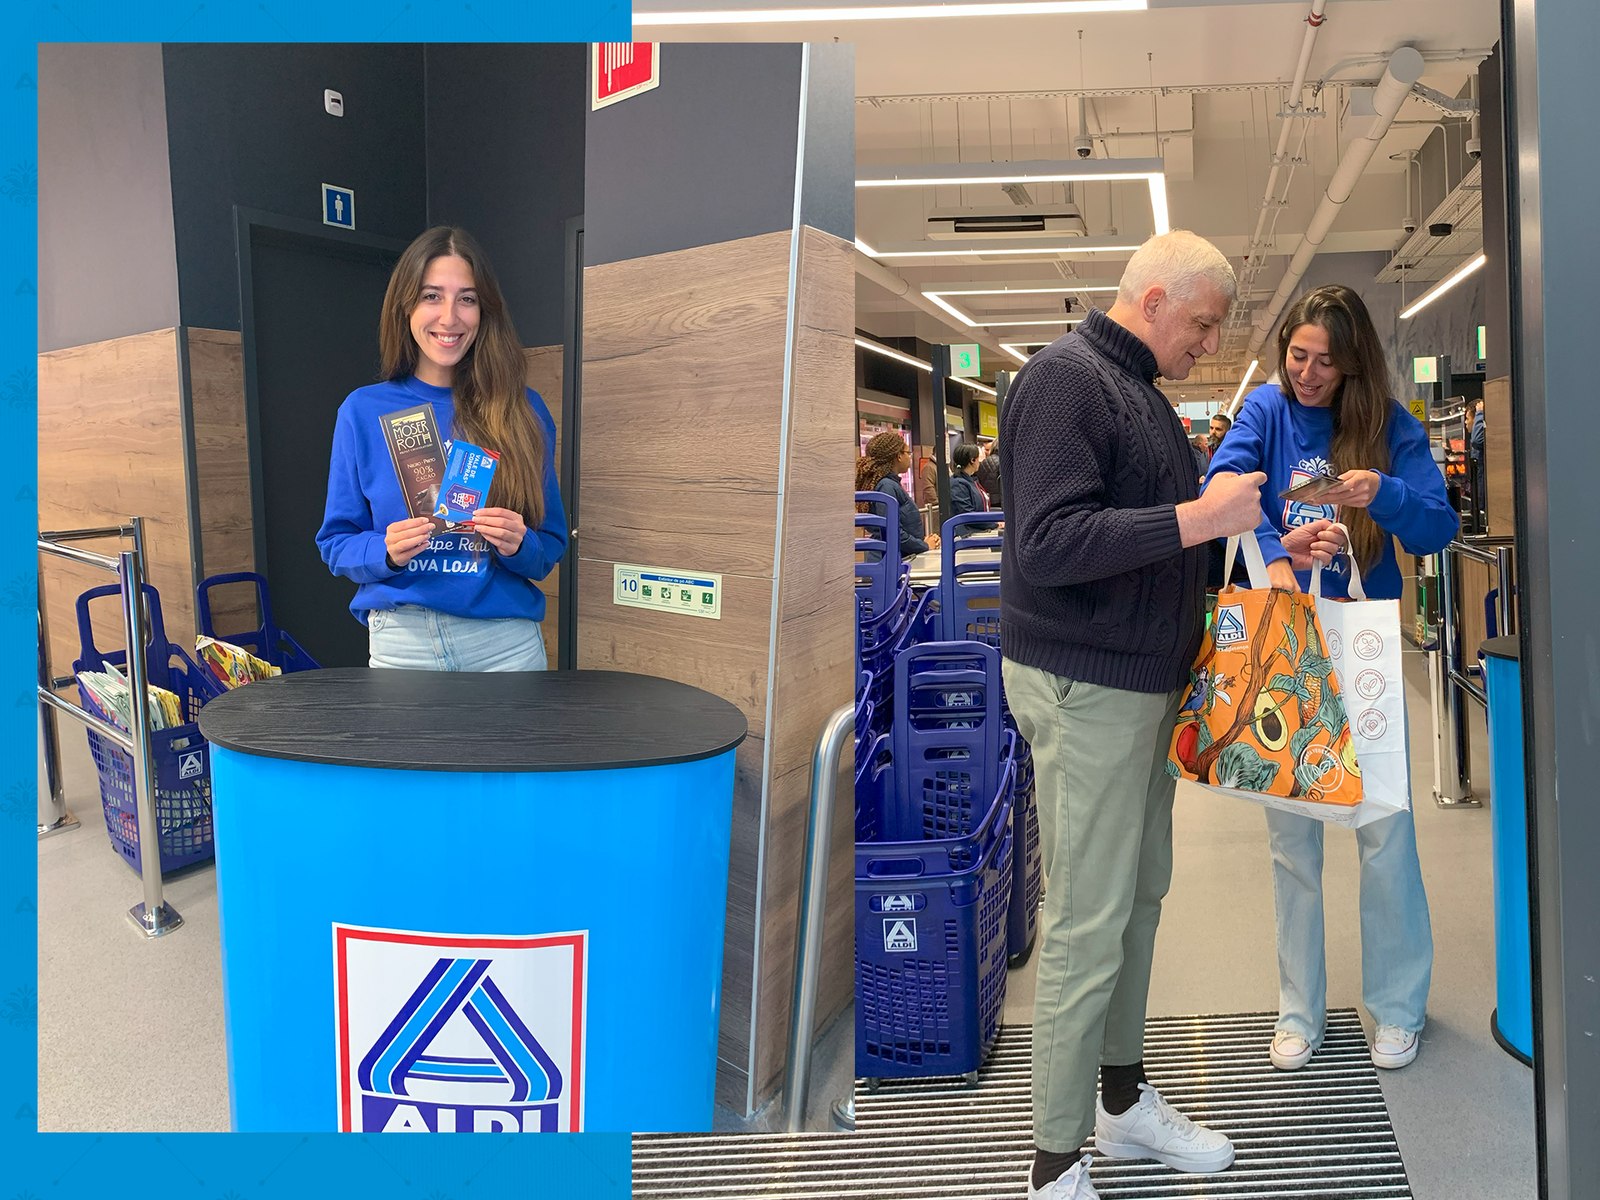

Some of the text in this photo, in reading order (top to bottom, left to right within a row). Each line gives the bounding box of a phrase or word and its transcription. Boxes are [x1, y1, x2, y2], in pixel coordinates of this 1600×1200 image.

[959, 352, 971, 369] 3
[393, 420, 429, 439] MOSER
[396, 431, 433, 451] ROTH
[413, 465, 434, 477] 90%
[469, 454, 481, 478] VALE DE
[415, 472, 436, 483] CACAO
[458, 537, 490, 552] Real
[406, 559, 479, 573] OVA LOJA
[621, 578, 638, 593] 10
[1218, 630, 1243, 641] ALDI
